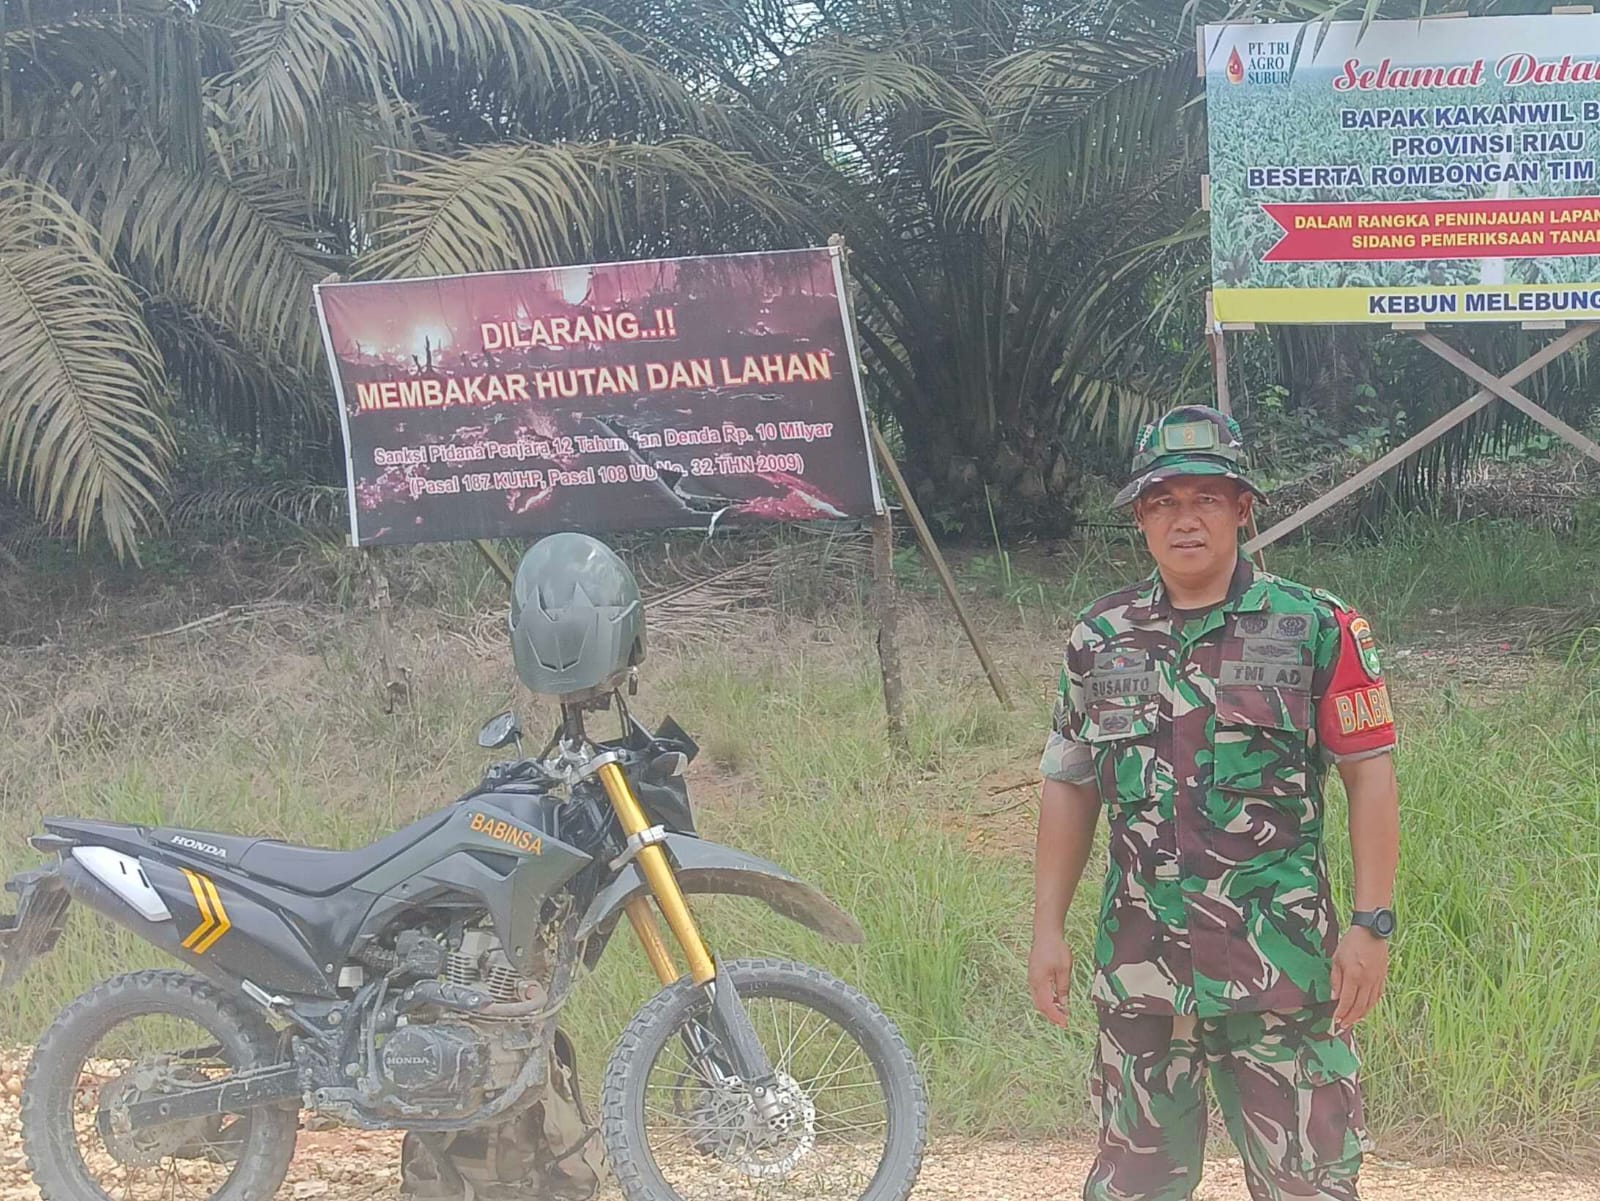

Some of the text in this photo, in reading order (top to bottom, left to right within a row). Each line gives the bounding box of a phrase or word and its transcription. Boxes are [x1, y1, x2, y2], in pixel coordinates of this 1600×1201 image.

[1248, 42, 1289, 55] PT. TRI
[1248, 56, 1285, 70] AGRO
[1334, 52, 1600, 90] Selamat Data
[1248, 71, 1290, 85] SUBUR
[1341, 106, 1427, 129] BAPAK
[1434, 103, 1575, 127] KAKANWIL
[1392, 131, 1585, 157] PROVINSI RIAU
[1248, 160, 1594, 187] BESERTA ROMBONGAN TIM
[1294, 215, 1353, 229] DALAM
[1357, 213, 1430, 228] RANGKA
[1434, 211, 1545, 227] PENINJAUAN
[1352, 229, 1600, 249] SIDANG PEMERIKSAAN TANA
[1369, 294, 1457, 315] KEBUN
[356, 351, 833, 411] MEMBAKAR HUTAN DAN LAHAN
[374, 447, 428, 466] Sanksi
[428, 443, 486, 463] Pidana
[486, 439, 550, 462] Penjara
[551, 437, 574, 454] 12
[664, 427, 721, 446] Denda
[721, 424, 754, 445] Rp.
[756, 423, 777, 441] 10
[779, 420, 833, 442] Milyar
[408, 476, 461, 497] (Pasal
[462, 474, 491, 492] 187
[493, 471, 547, 491] KUHP,
[547, 467, 595, 486] Pasal
[597, 464, 628, 483] 108
[690, 458, 714, 476] 32
[716, 456, 756, 475] THN
[756, 454, 804, 474] 2009)
[1233, 664, 1302, 686] TNI AD
[1091, 677, 1149, 697] SUSANTO
[470, 812, 545, 857] BABINSA
[170, 835, 227, 858] HONDA
[386, 1056, 430, 1065] HONDA
